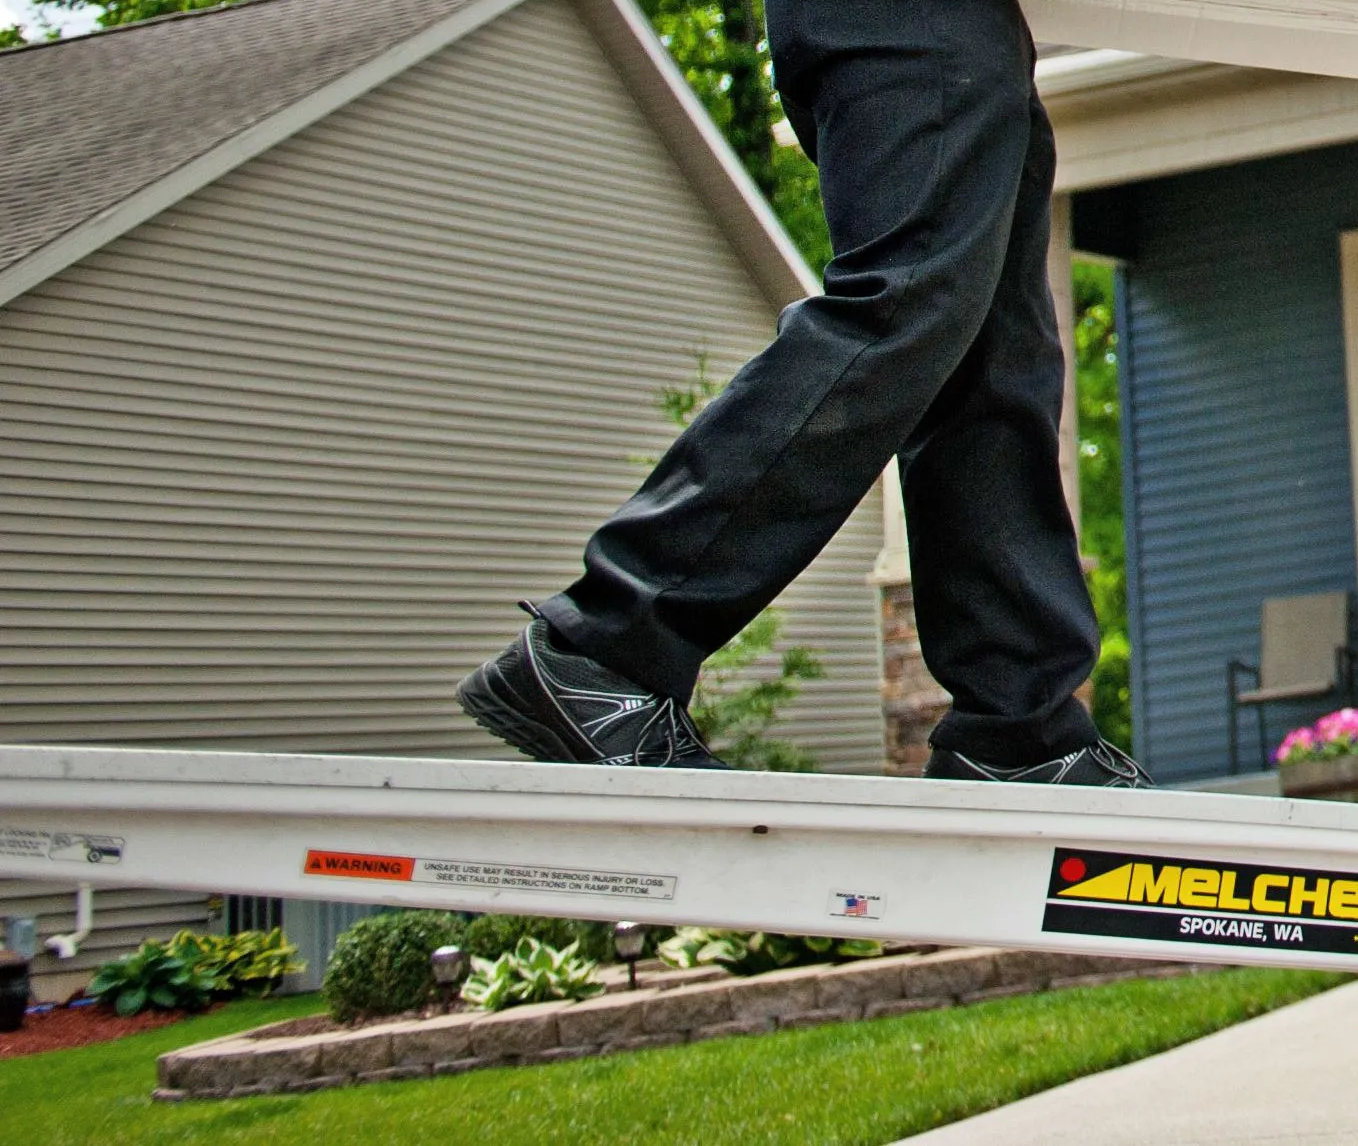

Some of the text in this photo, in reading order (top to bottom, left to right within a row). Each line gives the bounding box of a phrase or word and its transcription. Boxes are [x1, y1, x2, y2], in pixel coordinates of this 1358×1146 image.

[325, 858, 402, 875] WARNING
[424, 862, 460, 872] UNSAFE
[483, 867, 501, 875] MAY
[504, 869, 538, 878] RESULT
[551, 872, 589, 881] SERIOUS
[592, 875, 623, 884] INJURY
[641, 879, 664, 887] LOSS.
[436, 873, 454, 881] SEE
[456, 874, 500, 884] DETAILED
[502, 877, 566, 888] INSTRUCTIONS
[611, 886, 649, 894] BOTTOM.
[1180, 916, 1304, 941] SPOKANE, WA
